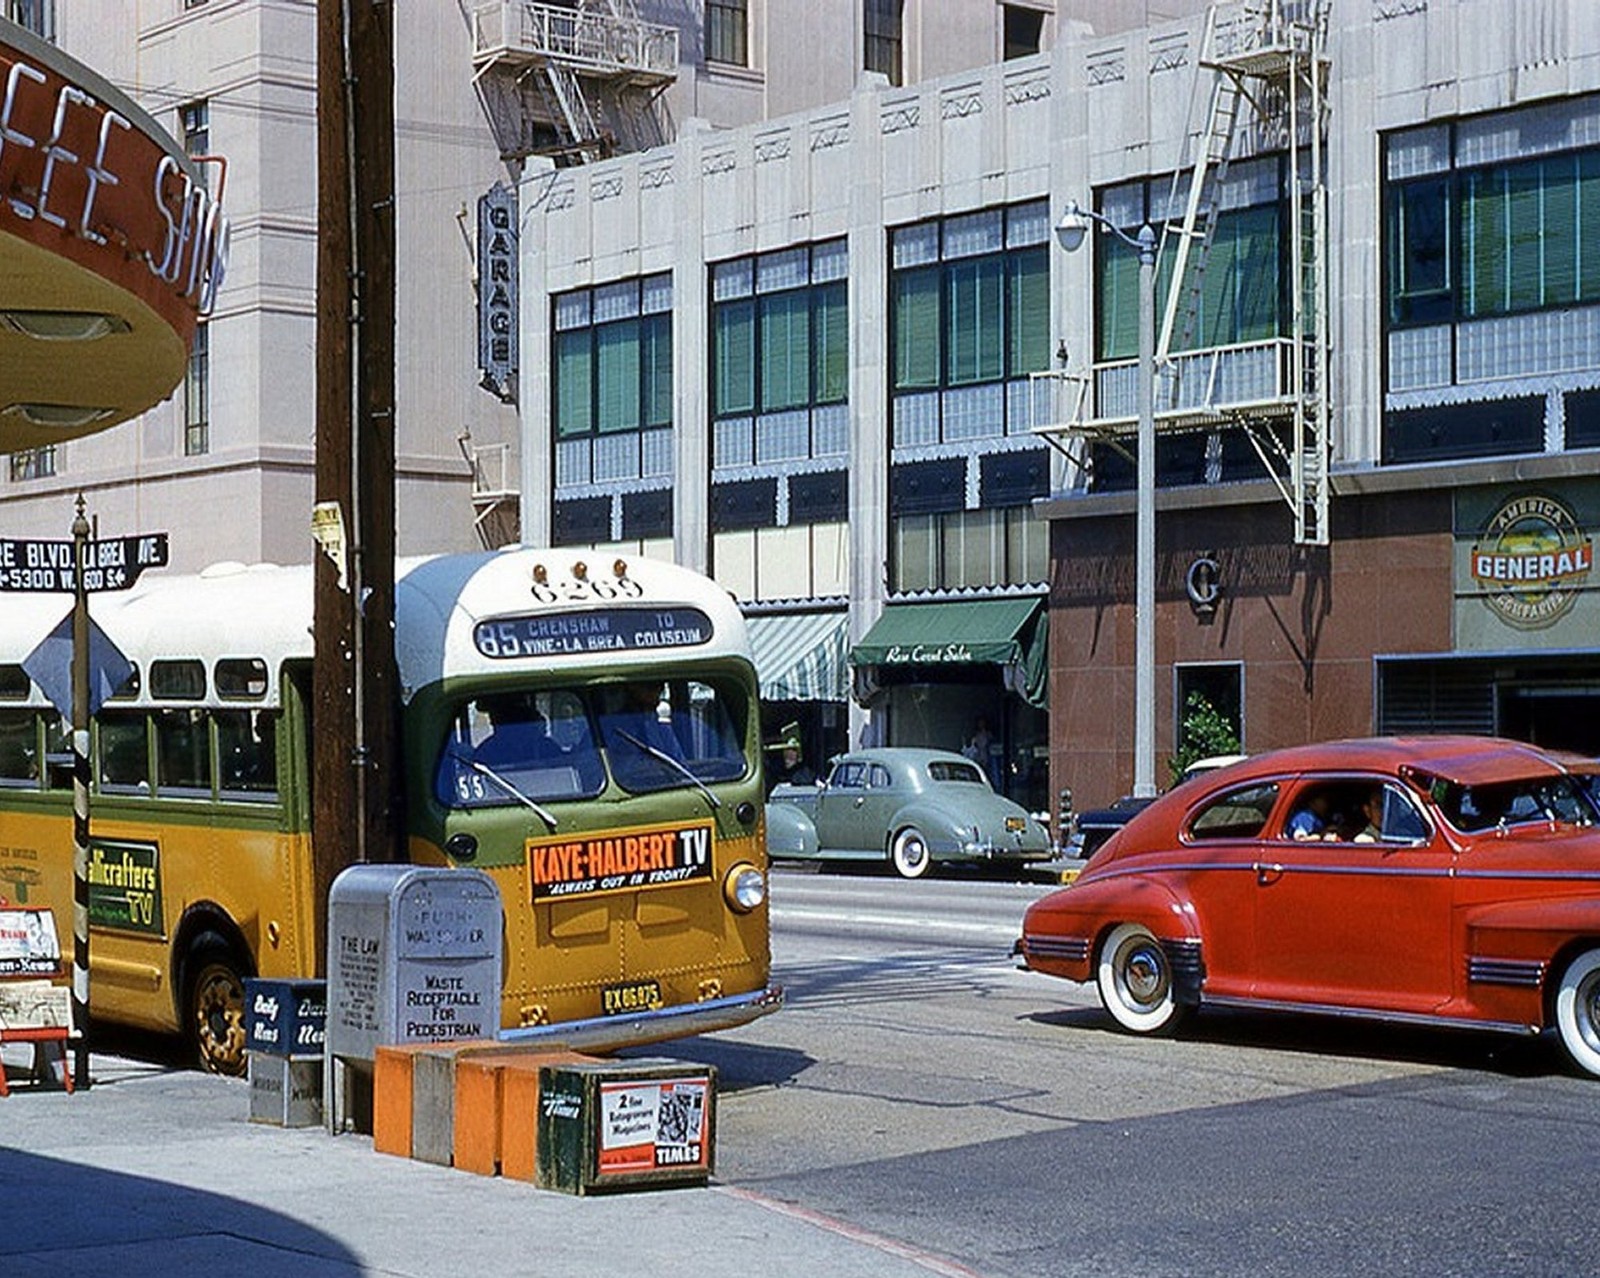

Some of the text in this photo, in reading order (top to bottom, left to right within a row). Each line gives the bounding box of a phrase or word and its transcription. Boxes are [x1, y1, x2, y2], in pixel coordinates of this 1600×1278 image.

[488, 206, 511, 362] GARAGE
[27, 543, 76, 568] BLVD.
[82, 537, 160, 569] LA BREA AVE
[1477, 549, 1589, 579] GENERAL
[9, 569, 76, 589] 5300 W.
[531, 577, 643, 603] 6269
[528, 613, 673, 638] CRENSHAW TO
[477, 622, 519, 656] 85
[588, 635, 625, 650] BREA
[635, 628, 700, 646] COLISEUM
[680, 829, 708, 865] TV
[601, 876, 625, 889] OUT
[630, 874, 645, 886] IN
[126, 891, 153, 925] TV
[425, 975, 464, 990] WASTE
[406, 990, 481, 1007] RECEPTACLE
[432, 1007, 456, 1021] FOR
[406, 1021, 481, 1037] PEDESTRIAN
[619, 1094, 628, 1109] 2
[656, 1145, 701, 1165] TIMES
